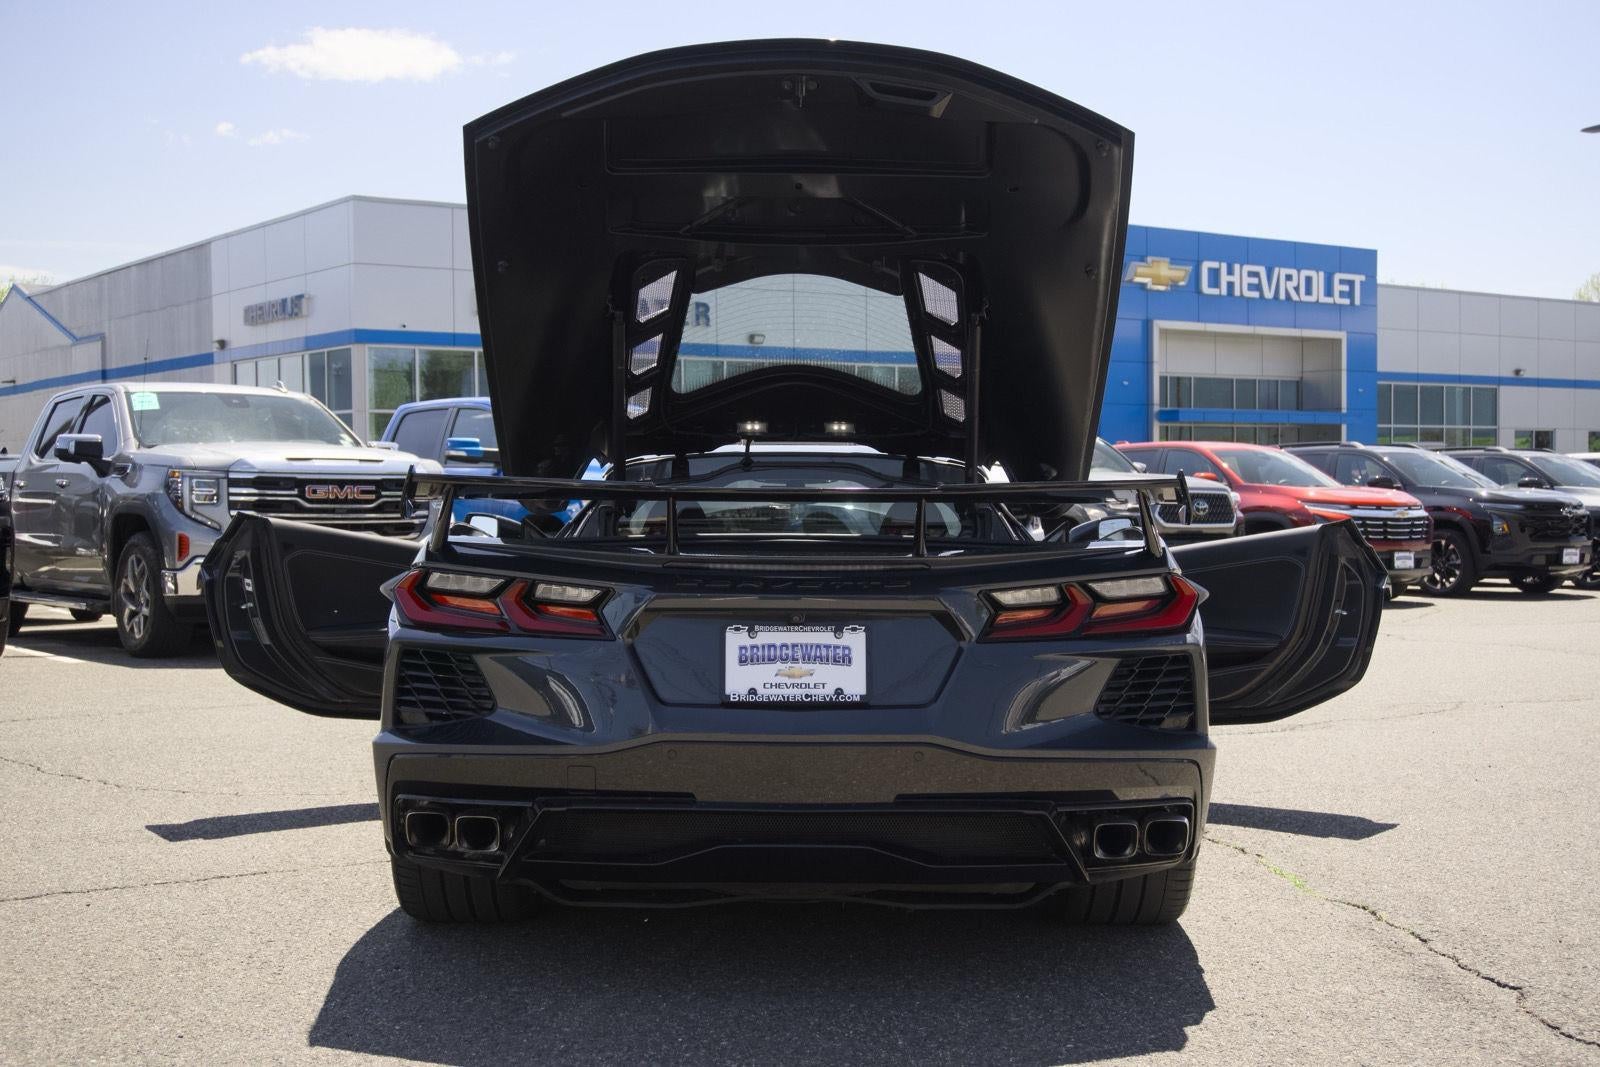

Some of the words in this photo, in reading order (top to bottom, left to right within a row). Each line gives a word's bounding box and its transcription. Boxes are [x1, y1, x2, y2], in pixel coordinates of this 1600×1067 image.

[1201, 260, 1366, 306] CHEVROLET
[305, 484, 376, 500] GMC
[738, 642, 852, 667] BRIDGEWATER
[762, 682, 828, 690] CHEVROLET
